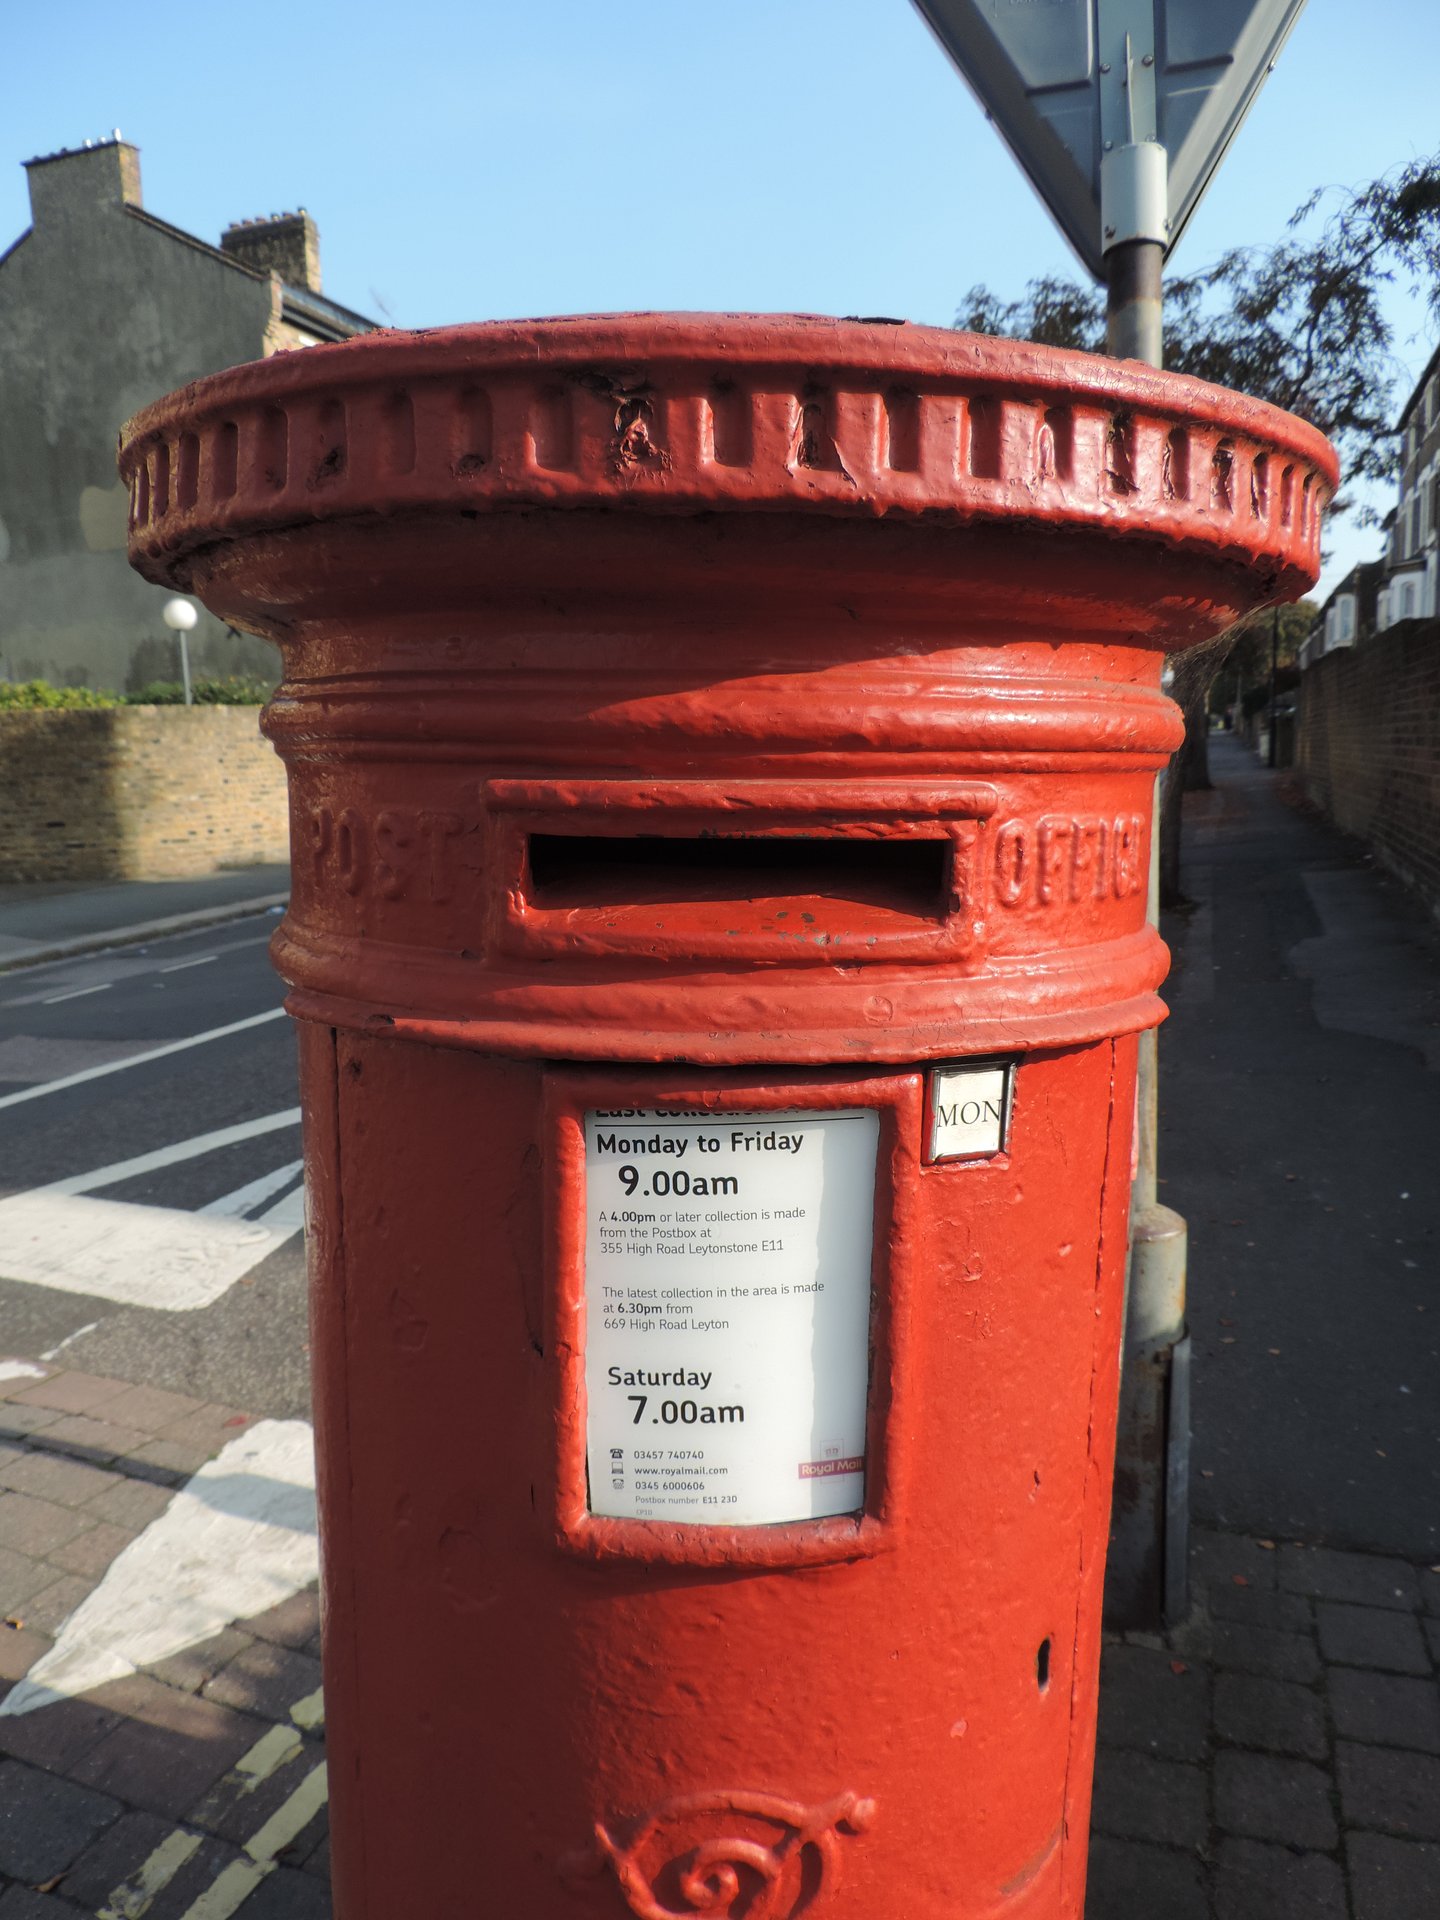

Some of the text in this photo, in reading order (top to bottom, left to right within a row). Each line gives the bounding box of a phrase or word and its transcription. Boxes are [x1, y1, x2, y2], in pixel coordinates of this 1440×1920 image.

[937, 1099, 1002, 1127] MON
[596, 1130, 804, 1159] Monday to Friday
[618, 1164, 739, 1197] 9.00am
[598, 1206, 806, 1225] A 4.00pm or later collection is made
[599, 1226, 712, 1239] from the Postbox at
[600, 1239, 784, 1257] 355 High Road Leytonstone E11
[602, 1280, 825, 1299] The latest collection in the area is made
[602, 1302, 693, 1317] at 6.30pm from
[603, 1317, 730, 1332] 669 High Road Leyton
[607, 1366, 713, 1391] Saturday
[627, 1395, 745, 1425] 7.00am
[633, 1450, 704, 1460] 03457 740740
[634, 1465, 728, 1477] www.royalmail.com
[802, 1459, 862, 1475] Royal Mail
[635, 1480, 705, 1491] 0345 6000606
[635, 1495, 666, 1504] Postbox
[667, 1495, 700, 1505] number
[702, 1495, 718, 1504] E11
